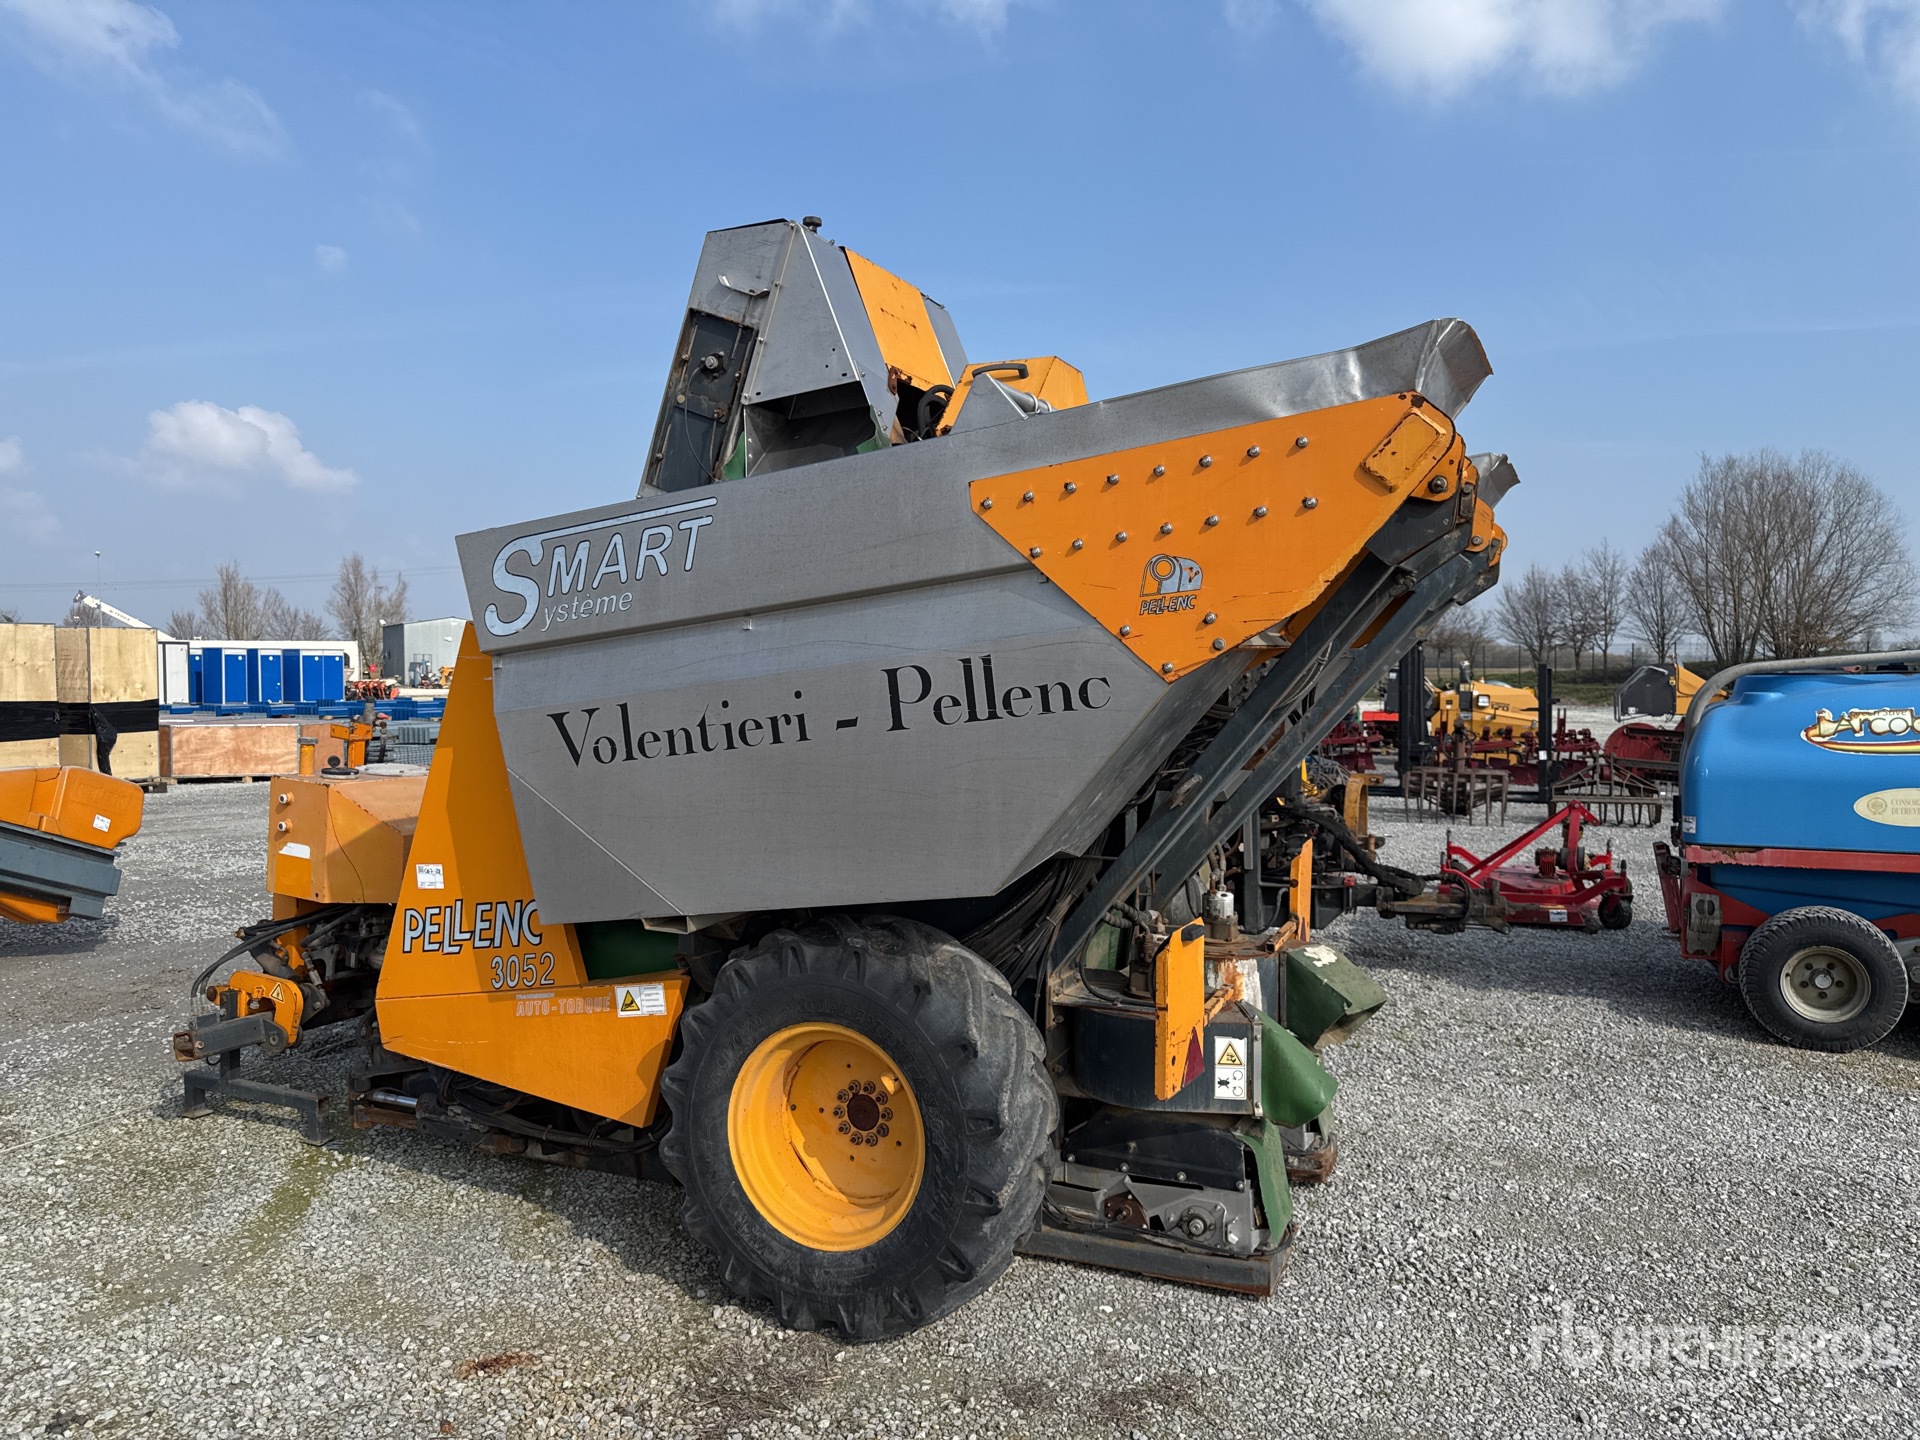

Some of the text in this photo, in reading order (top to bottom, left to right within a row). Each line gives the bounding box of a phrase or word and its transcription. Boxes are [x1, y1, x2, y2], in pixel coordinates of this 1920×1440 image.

[483, 497, 718, 637] SMART
[1139, 594, 1197, 616] PELLENC
[546, 653, 1111, 767] Volentieri - Pellenc
[402, 898, 543, 955] PELLENC
[490, 951, 556, 990] 3052
